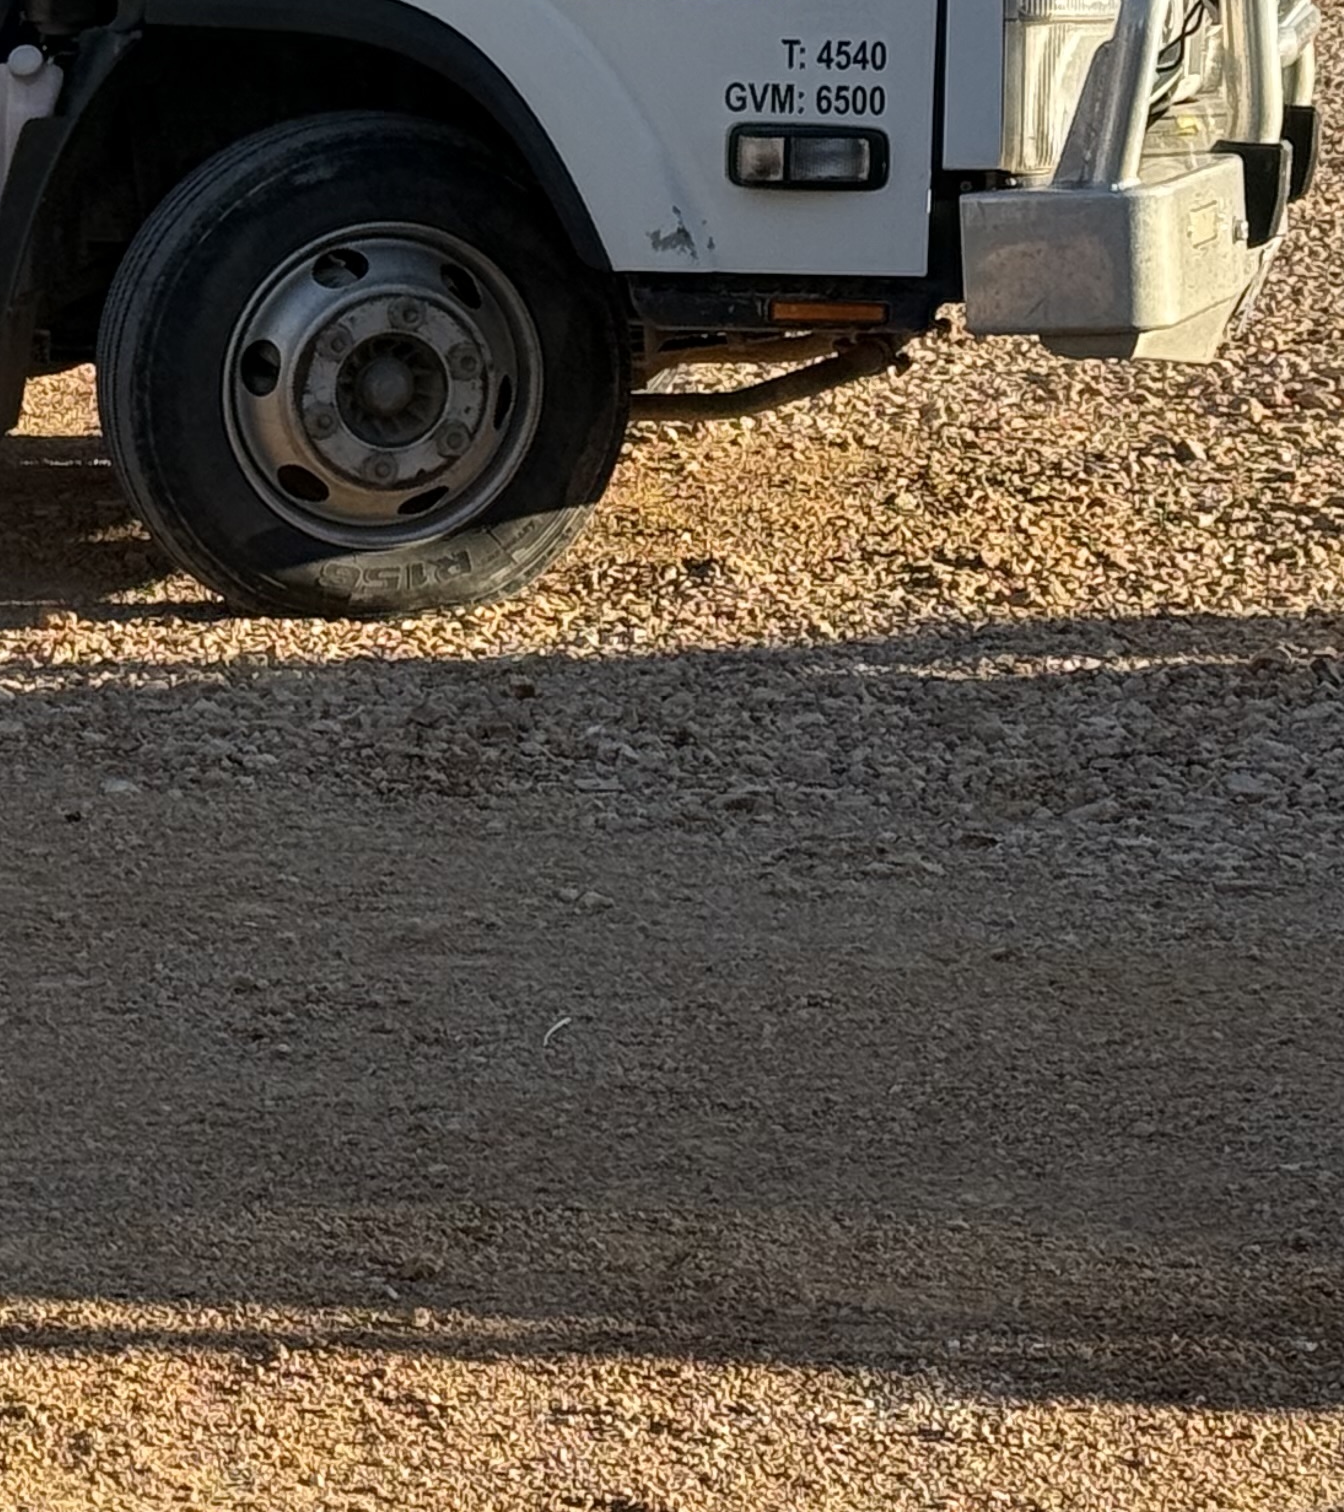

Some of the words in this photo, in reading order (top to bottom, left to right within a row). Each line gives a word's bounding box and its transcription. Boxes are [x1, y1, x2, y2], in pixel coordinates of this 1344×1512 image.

[781, 38, 806, 70] T:
[816, 39, 887, 71] 4540
[724, 82, 805, 115] GVM:
[816, 85, 886, 116] 6500
